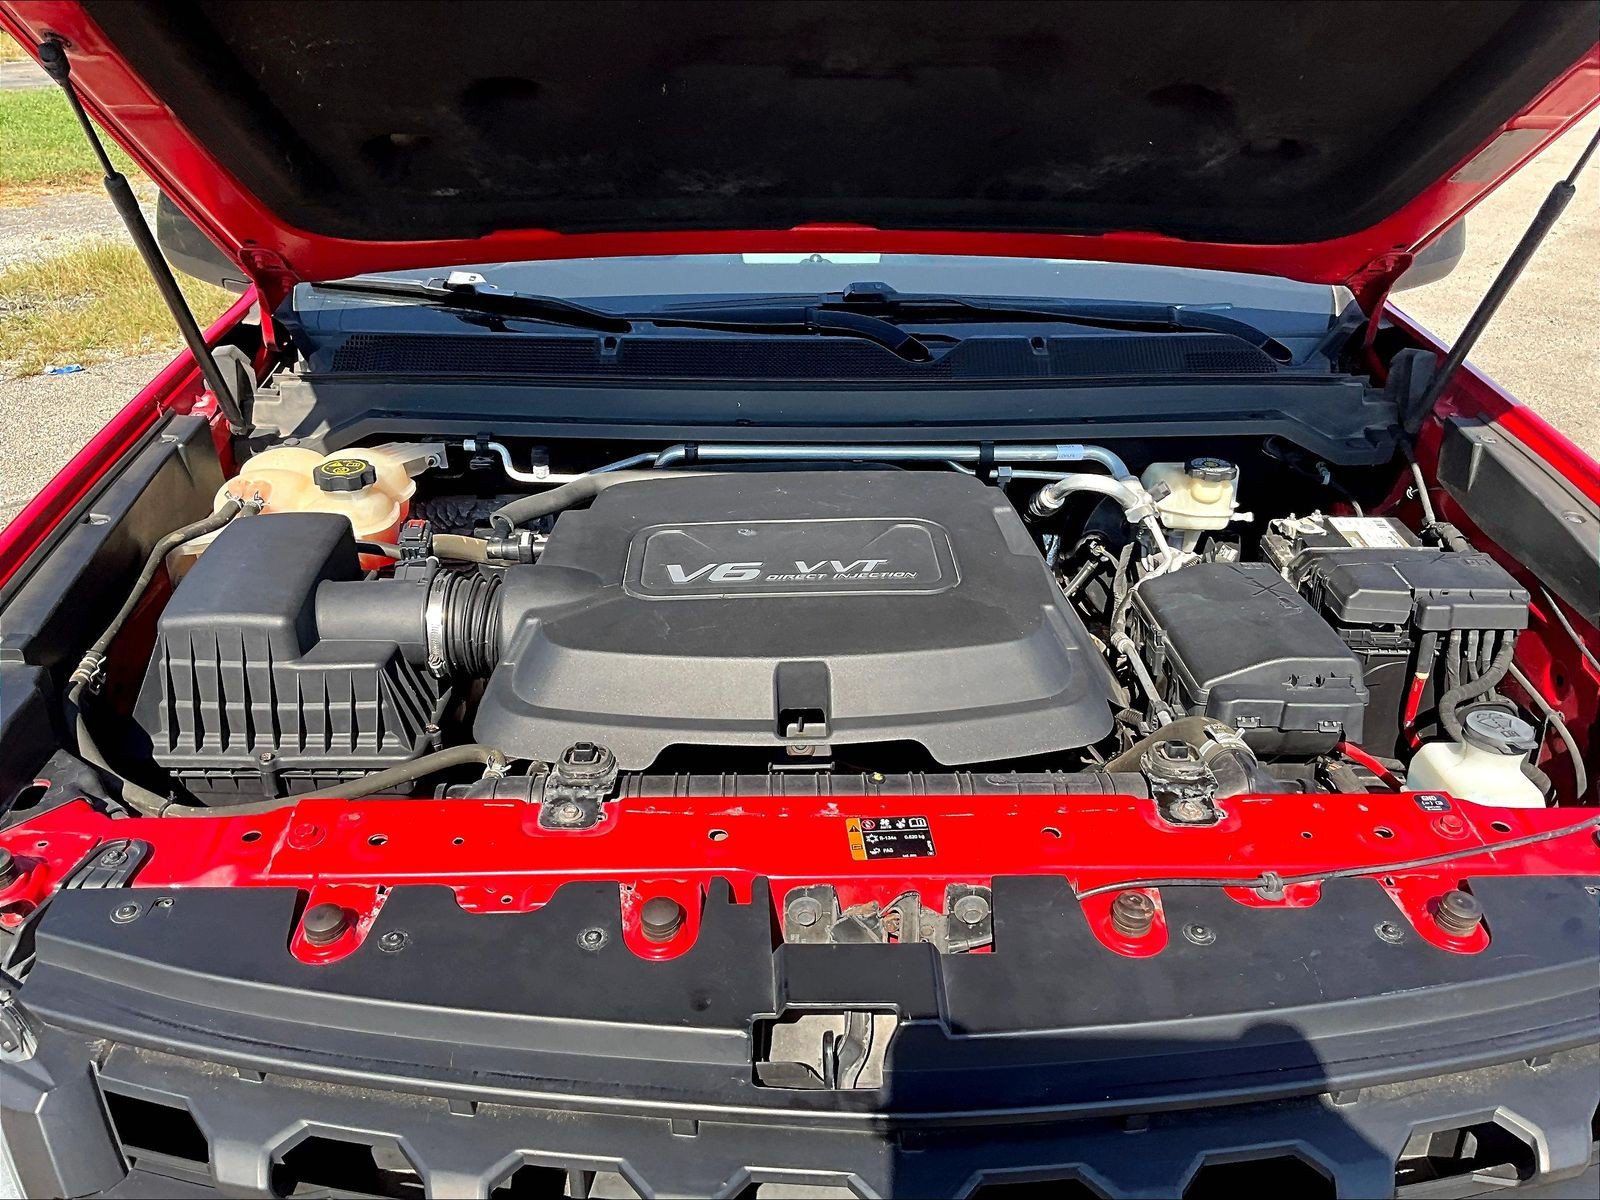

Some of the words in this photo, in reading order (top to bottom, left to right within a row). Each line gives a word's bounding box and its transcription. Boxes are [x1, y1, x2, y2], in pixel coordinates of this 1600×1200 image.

[666, 561, 763, 584] V6
[795, 559, 888, 573] VVT
[765, 573, 827, 581] DIRECT
[833, 571, 917, 579] INJECTION
